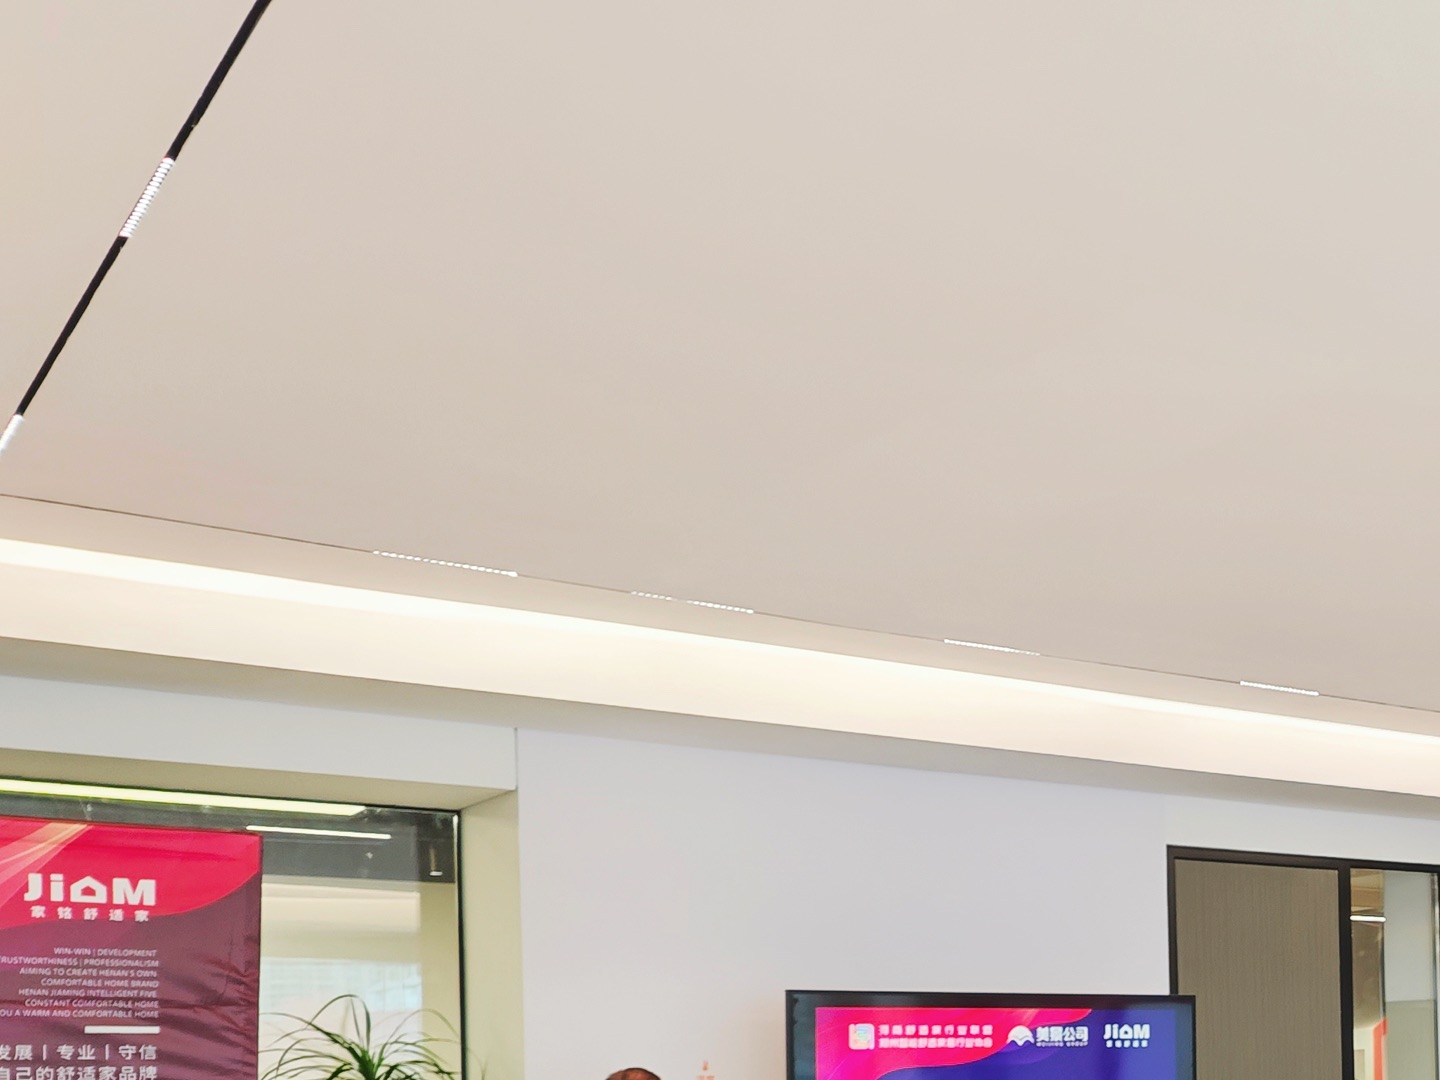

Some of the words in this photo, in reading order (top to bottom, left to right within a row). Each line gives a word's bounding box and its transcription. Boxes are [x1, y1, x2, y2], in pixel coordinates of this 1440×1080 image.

[30, 904, 150, 922] 家铭舒适家
[97, 948, 157, 957] DEVELOPMENT
[84, 958, 159, 968] PROFESSIONALISM
[19, 967, 51, 976] AIMING
[53, 967, 65, 976] TO
[66, 968, 97, 977] CREATE
[41, 977, 102, 987] COMFORTABLE
[104, 979, 129, 988] HOME
[18, 987, 49, 997] HENAN
[87, 988, 138, 998] INTELLIGENT
[25, 998, 71, 1008] CONSTANT
[72, 998, 132, 1009] COMFORTABLE
[134, 1000, 159, 1009] HOME
[14, 1008, 21, 1017] A
[22, 1008, 50, 1017] WARM
[52, 1009, 71, 1018] AND
[72, 1009, 132, 1018] COMFORTABLE
[134, 1010, 159, 1019] HOME
[56, 1043, 96, 1061] 专业
[118, 1043, 158, 1061] 守信
